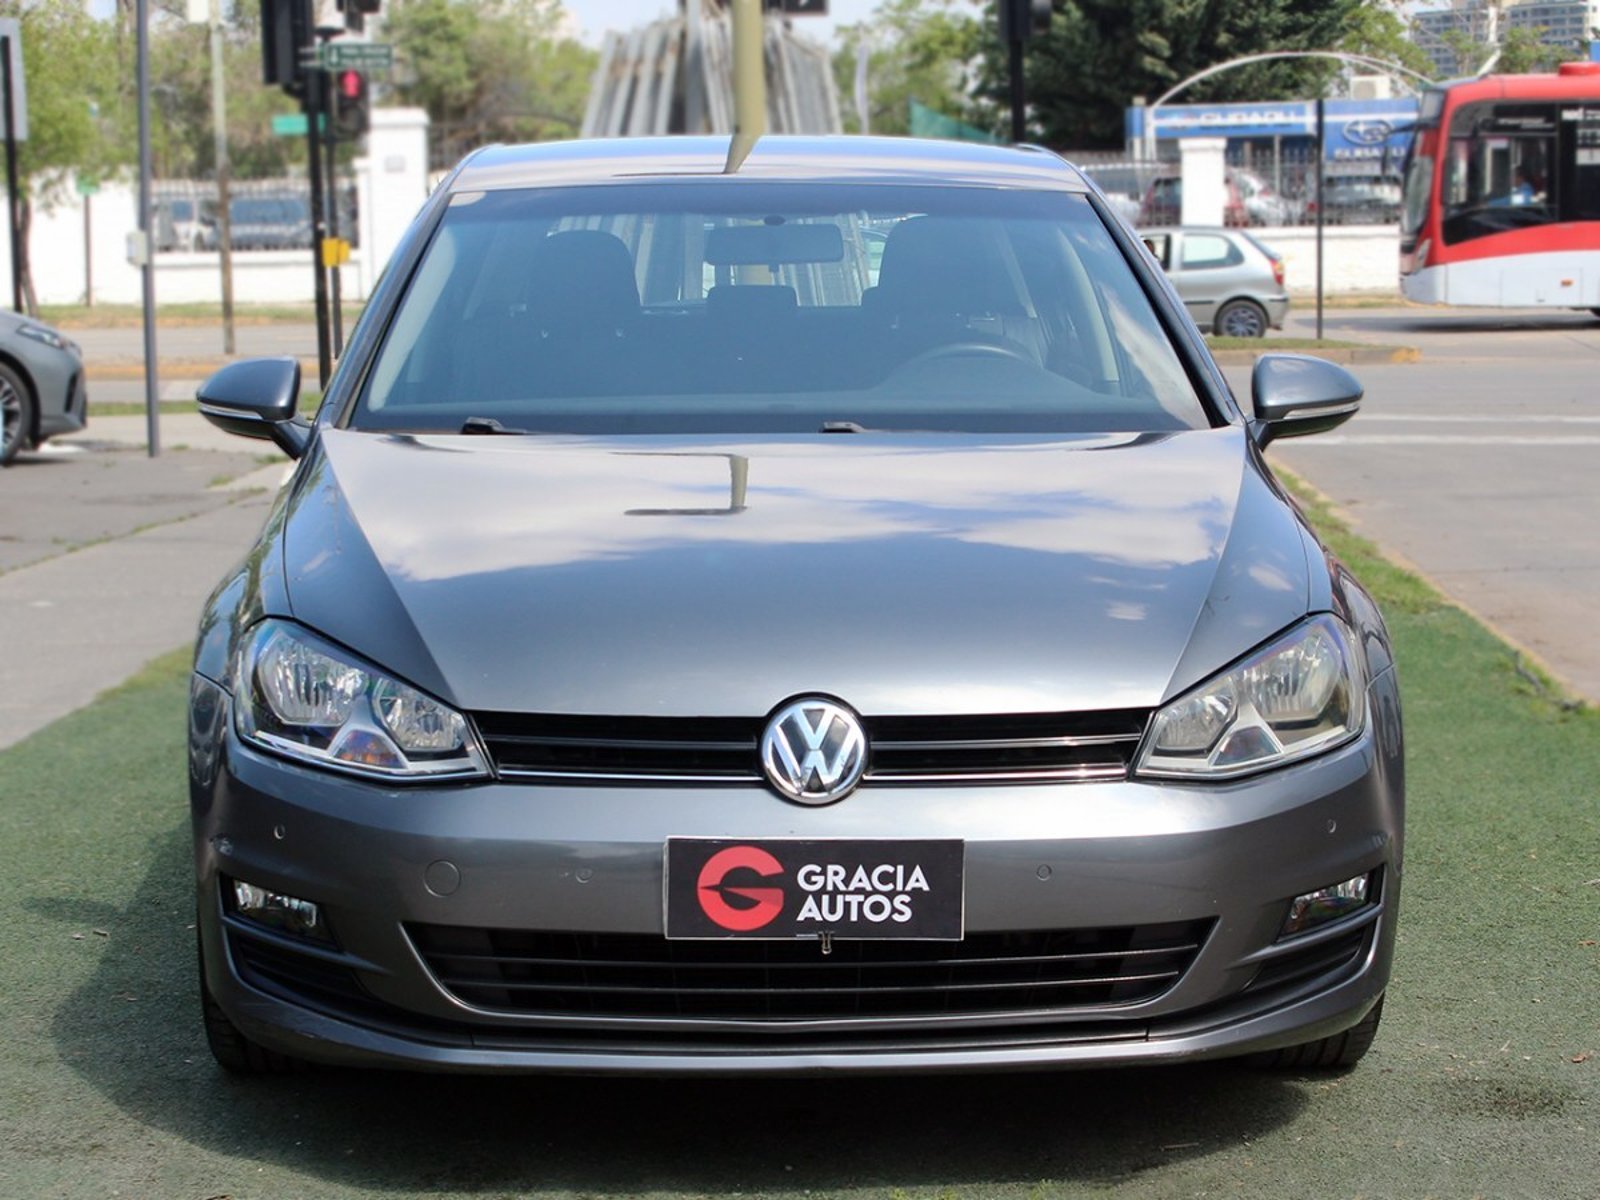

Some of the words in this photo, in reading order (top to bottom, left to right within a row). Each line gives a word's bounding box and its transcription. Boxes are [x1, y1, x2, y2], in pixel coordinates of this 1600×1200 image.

[1334, 146, 1406, 159] SUBAU
[768, 704, 860, 797] VW
[796, 864, 930, 892] GRACIA
[796, 893, 913, 923] AUTOS
